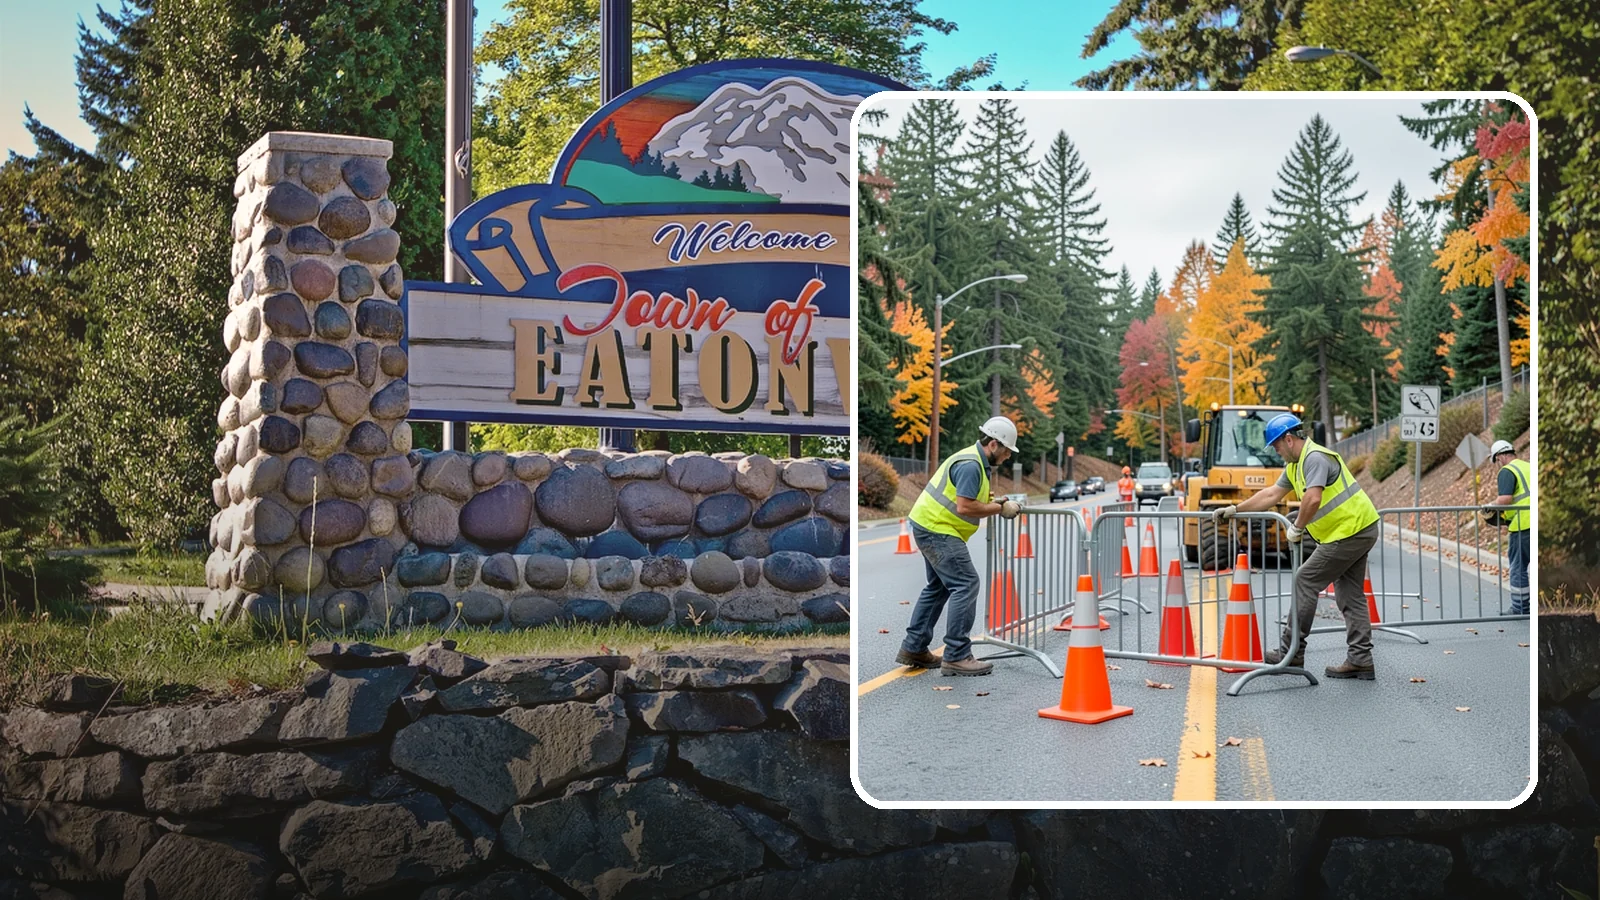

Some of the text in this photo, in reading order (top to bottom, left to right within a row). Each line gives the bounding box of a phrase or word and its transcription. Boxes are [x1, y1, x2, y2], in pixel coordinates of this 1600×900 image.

[653, 220, 837, 263] Welcome
[556, 263, 826, 365] Town of
